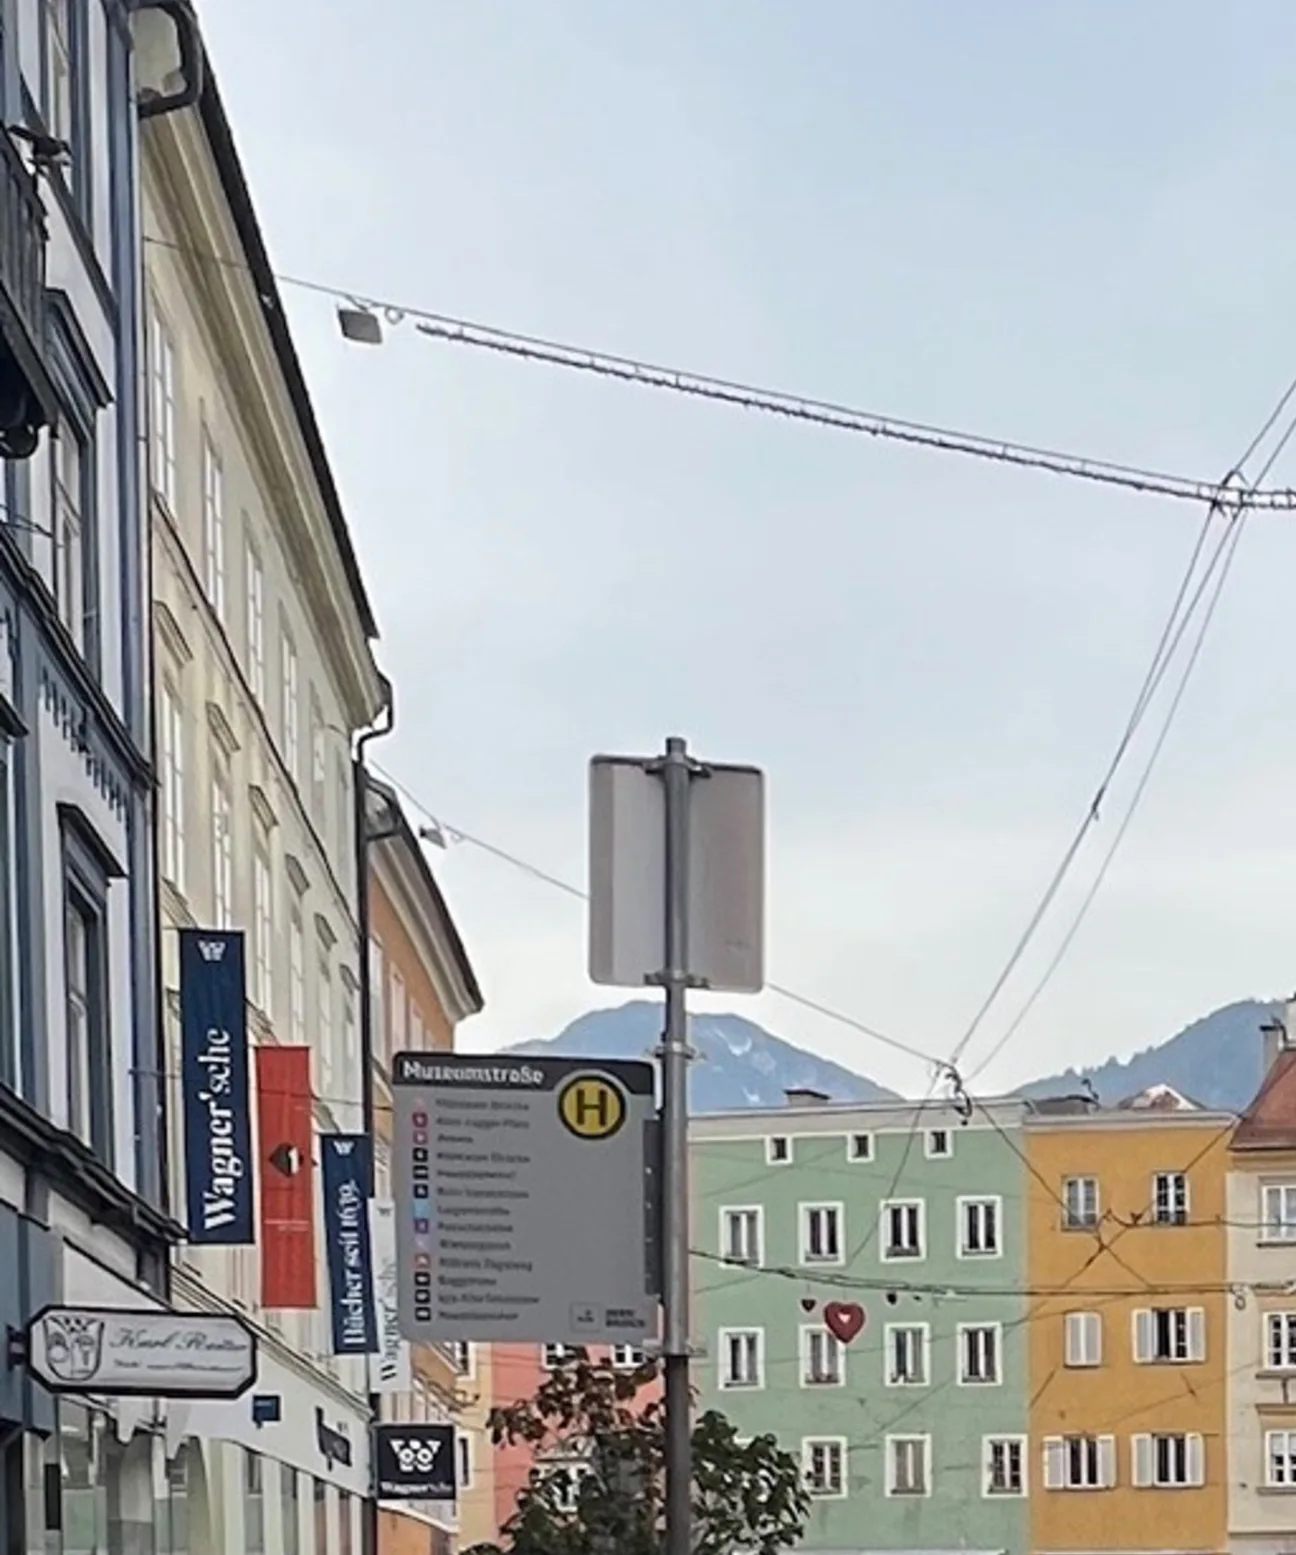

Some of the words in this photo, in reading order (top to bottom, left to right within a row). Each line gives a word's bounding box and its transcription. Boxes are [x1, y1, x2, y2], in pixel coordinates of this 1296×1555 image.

[402, 1060, 545, 1086] Museumstraße
[577, 1088, 608, 1127] H
[198, 1028, 244, 1231] Wagner'sche
[337, 1232, 361, 1268] seit
